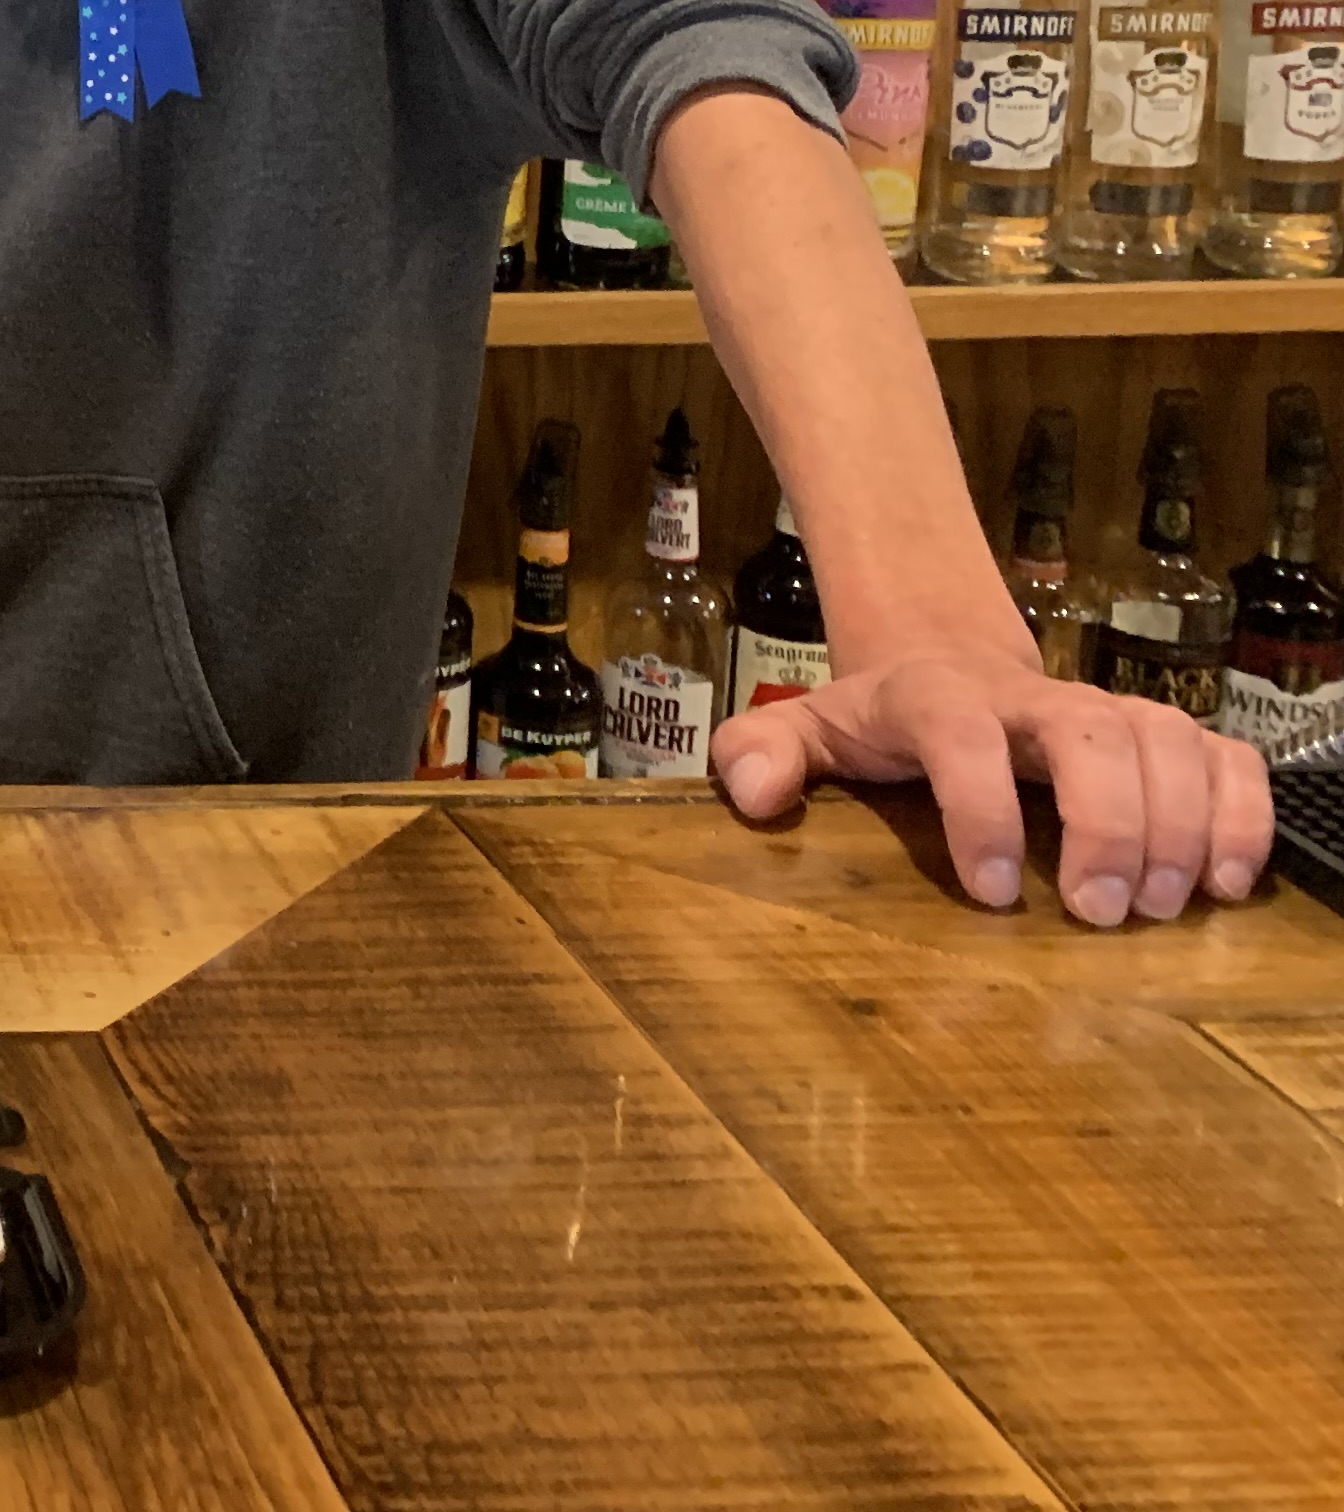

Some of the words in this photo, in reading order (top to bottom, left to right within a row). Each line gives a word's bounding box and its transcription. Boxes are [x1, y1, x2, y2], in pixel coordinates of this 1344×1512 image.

[1110, 11, 1211, 35] SMIRNOF
[1261, 6, 1344, 29] SMIRN
[650, 514, 683, 536] LORD
[753, 639, 828, 665] Seagram
[617, 686, 681, 724] LORD
[1229, 687, 1339, 723] WINDSO
[501, 725, 523, 741] DE
[526, 729, 592, 746] KUYPER
[602, 706, 700, 755] CALVERT
